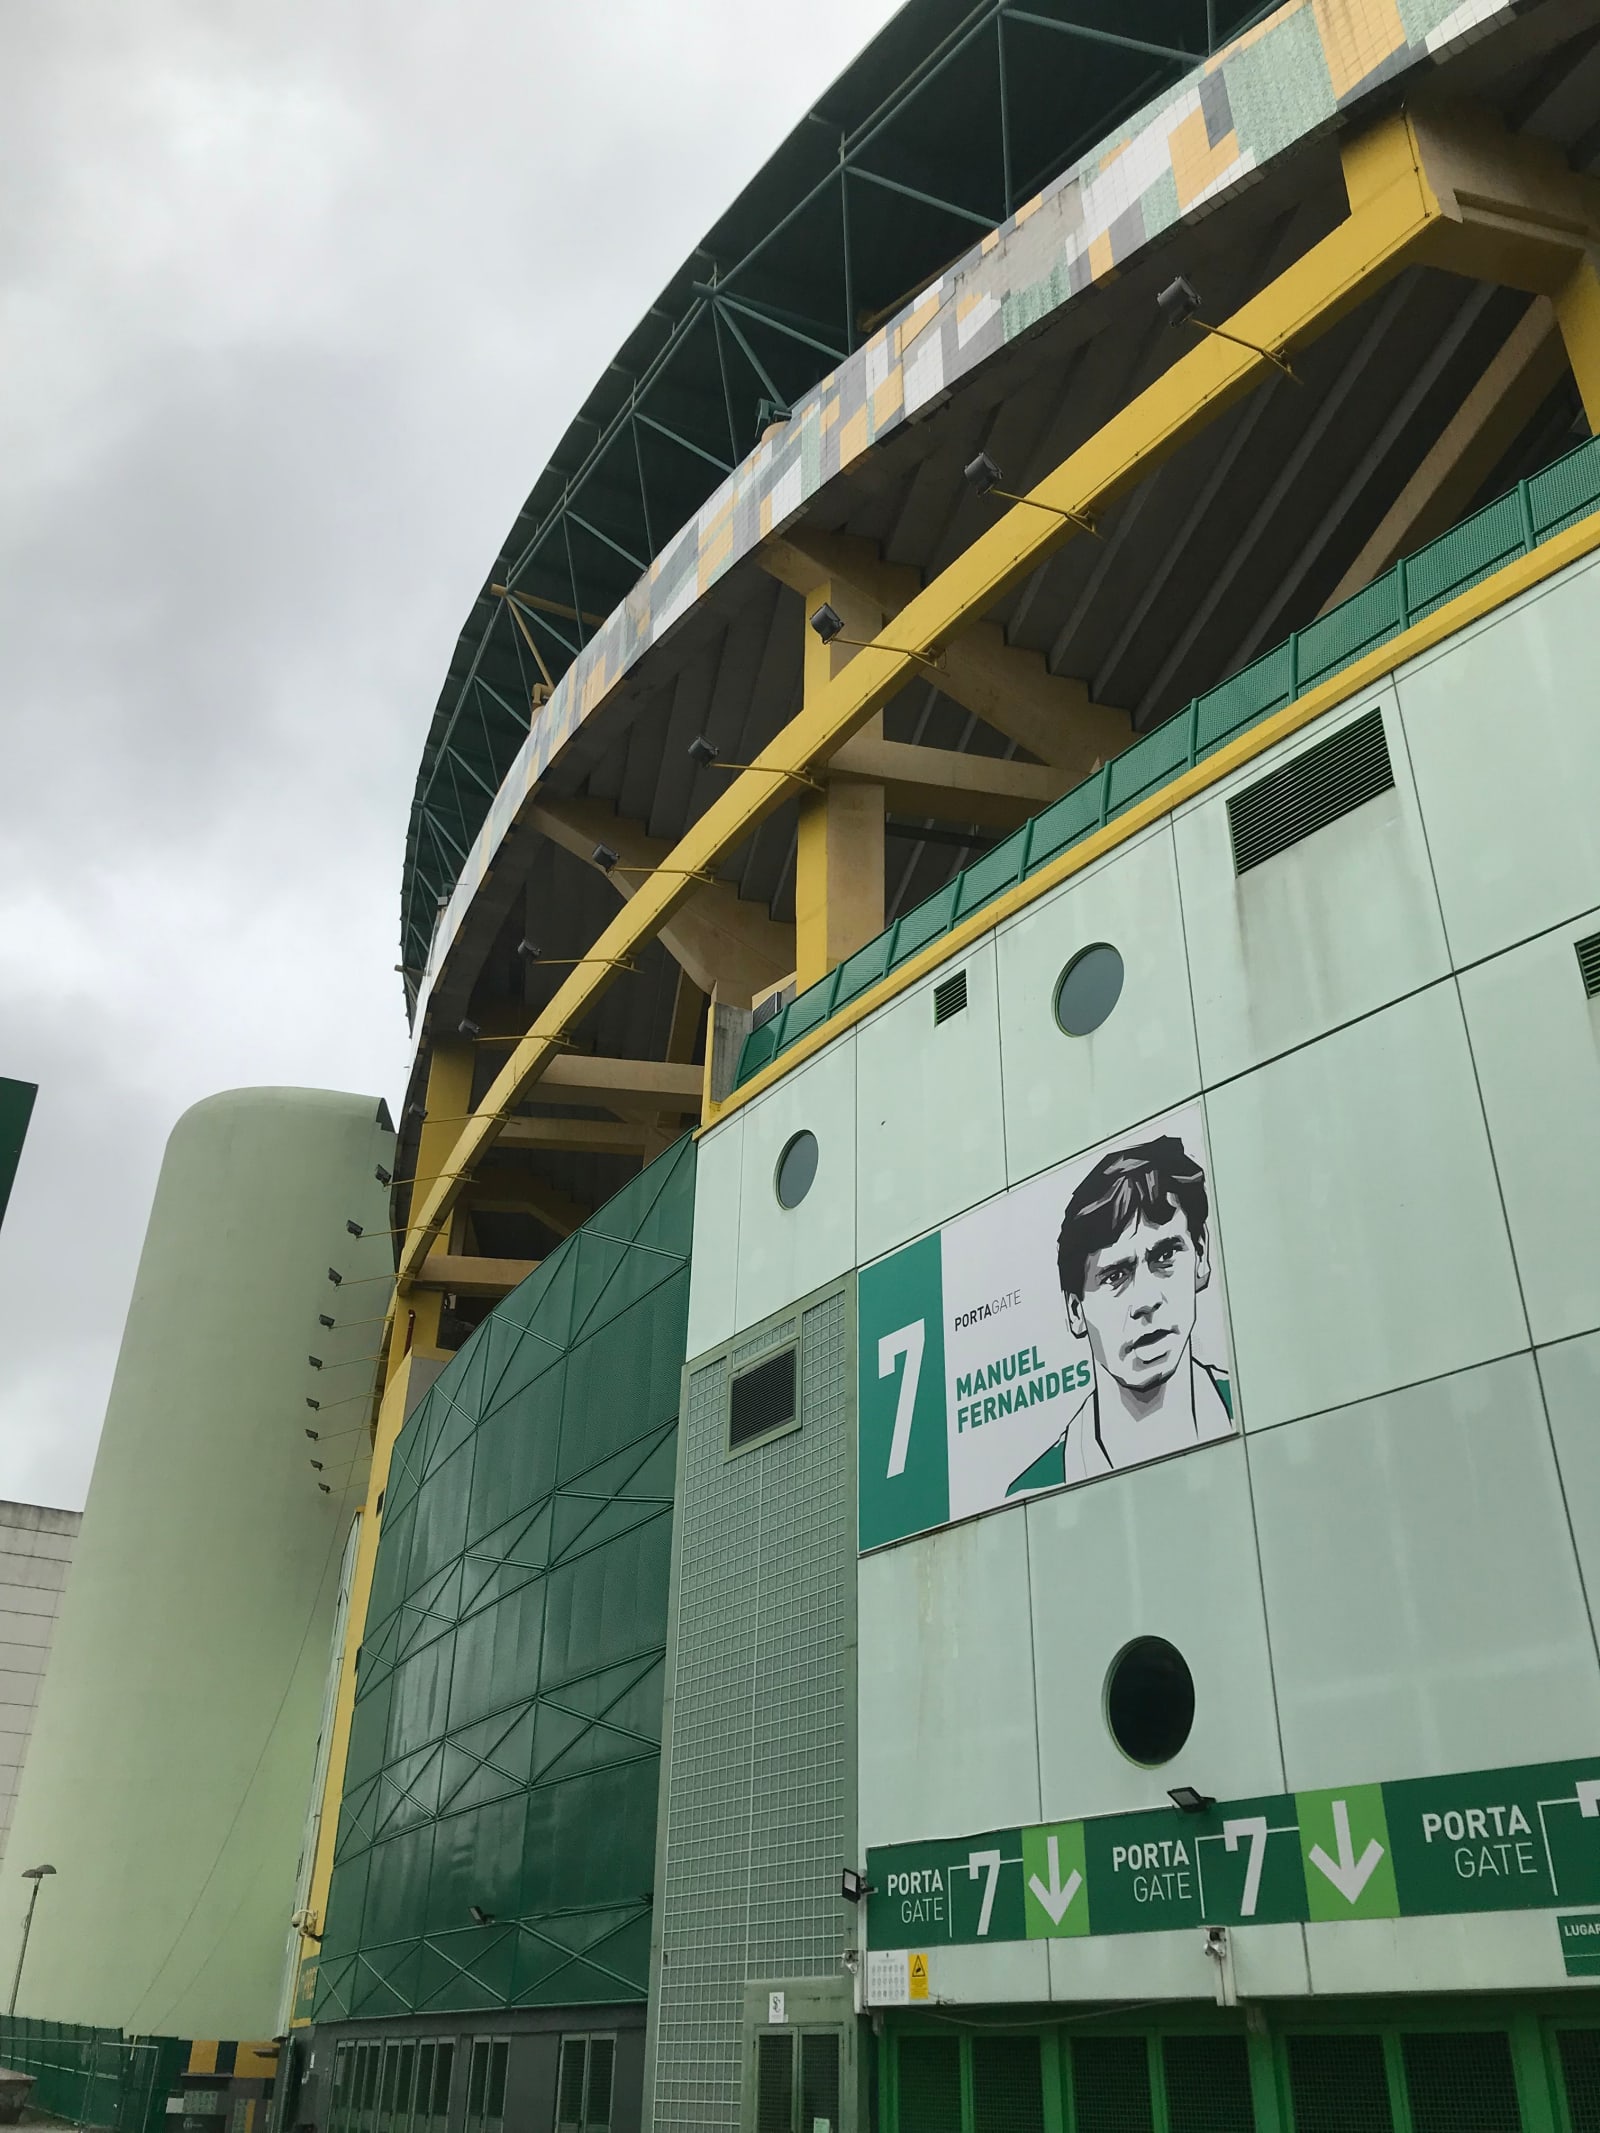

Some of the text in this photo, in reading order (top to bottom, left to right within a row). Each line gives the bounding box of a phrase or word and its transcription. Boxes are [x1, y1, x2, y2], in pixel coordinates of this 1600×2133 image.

[956, 1345, 1046, 1402] MANUEL
[878, 1318, 925, 1479] 7
[957, 1359, 1091, 1434] FERNANDES
[1421, 1804, 1532, 1843] PORTA
[1112, 1839, 1190, 1872] PORTA
[1223, 1816, 1267, 1917] 7
[1454, 1842, 1538, 1879] GATE
[887, 1869, 944, 1897] PORTA
[969, 1850, 1001, 1936] 7
[1133, 1872, 1192, 1903] GATE
[901, 1897, 944, 1924] GATE
